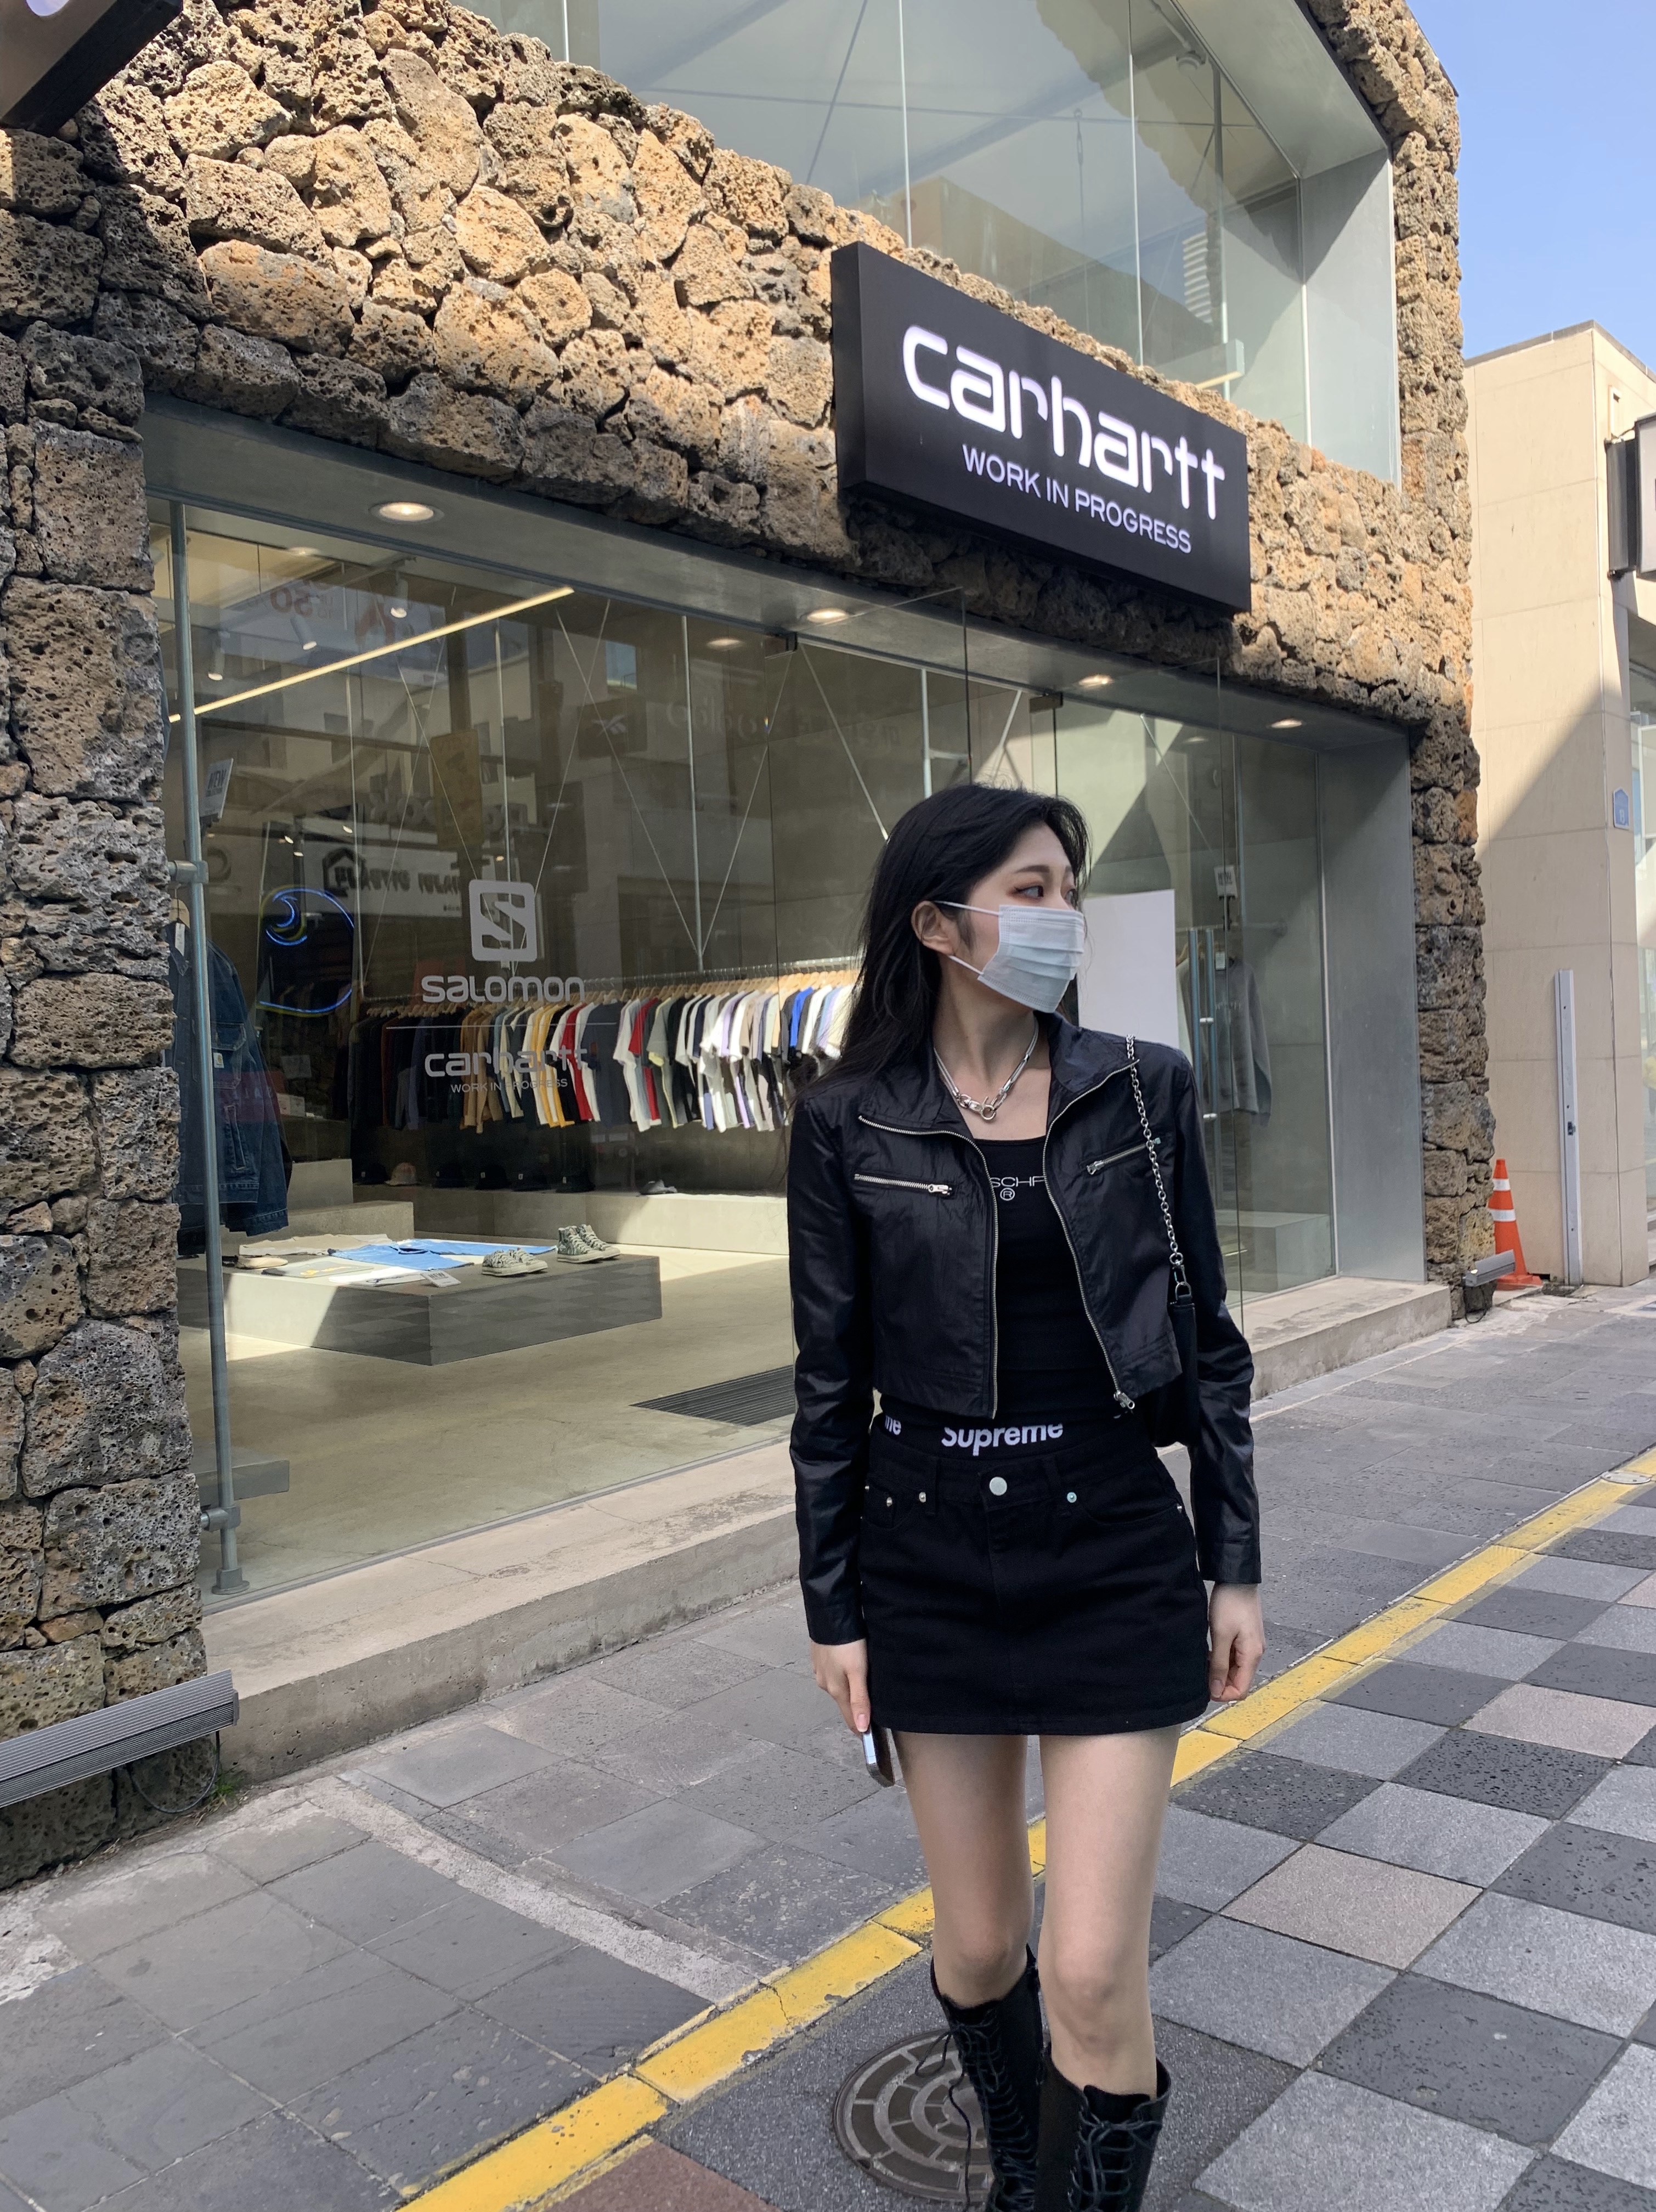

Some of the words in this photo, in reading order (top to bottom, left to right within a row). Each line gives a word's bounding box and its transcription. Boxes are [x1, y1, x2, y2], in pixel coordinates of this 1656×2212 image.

[903, 325, 1225, 520] carhartt
[962, 443, 1041, 497] WORK
[1046, 476, 1069, 508] IN
[1075, 489, 1191, 554] PROGRESS
[425, 1045, 587, 1077] carhartt
[450, 1081, 488, 1094] WORK
[491, 1082, 501, 1091] IN
[941, 1423, 1064, 1456] Supreme
